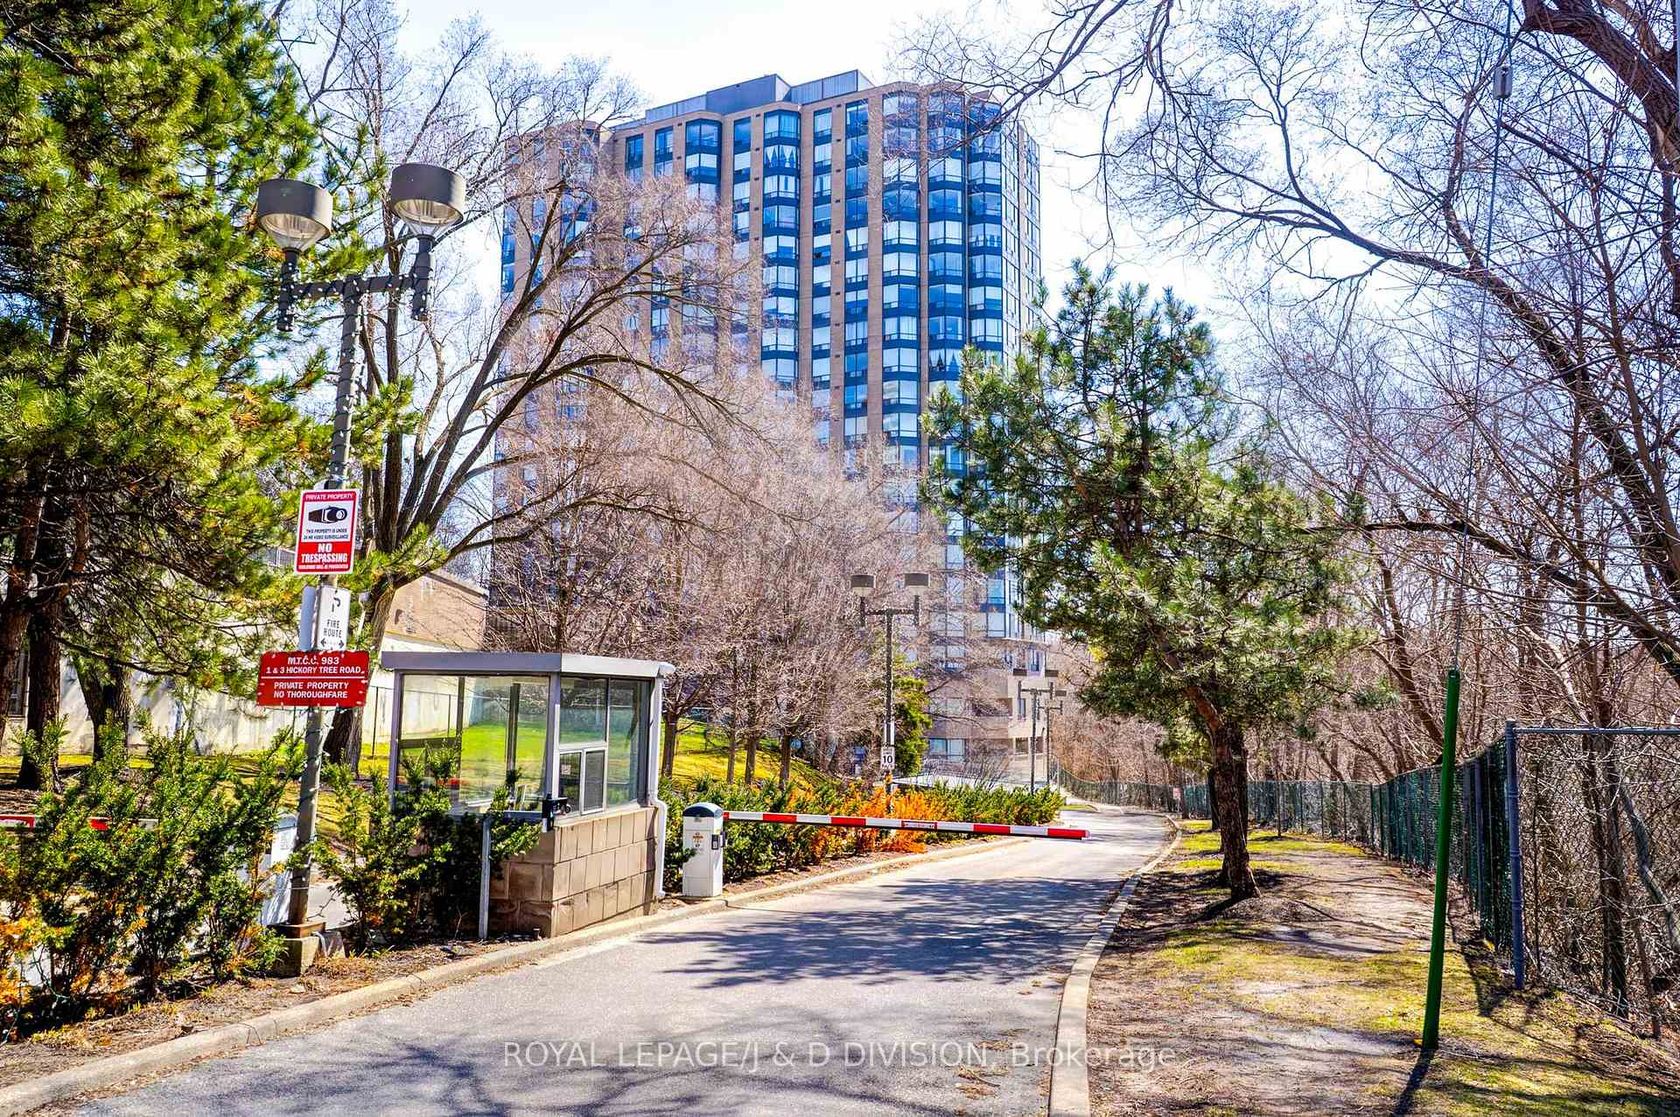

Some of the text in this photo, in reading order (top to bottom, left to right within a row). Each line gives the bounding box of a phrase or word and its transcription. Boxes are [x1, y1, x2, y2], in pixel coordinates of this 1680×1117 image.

[318, 543, 333, 553] NO
[301, 553, 348, 563] TRESPASSING
[327, 619, 341, 629] FIRE
[323, 628, 342, 638] ROUTE
[321, 657, 340, 665] 983
[274, 681, 350, 689] PRIVATE PROPERTY
[274, 690, 348, 698] NO THOROUGHFARE
[883, 755, 893, 763] 10
